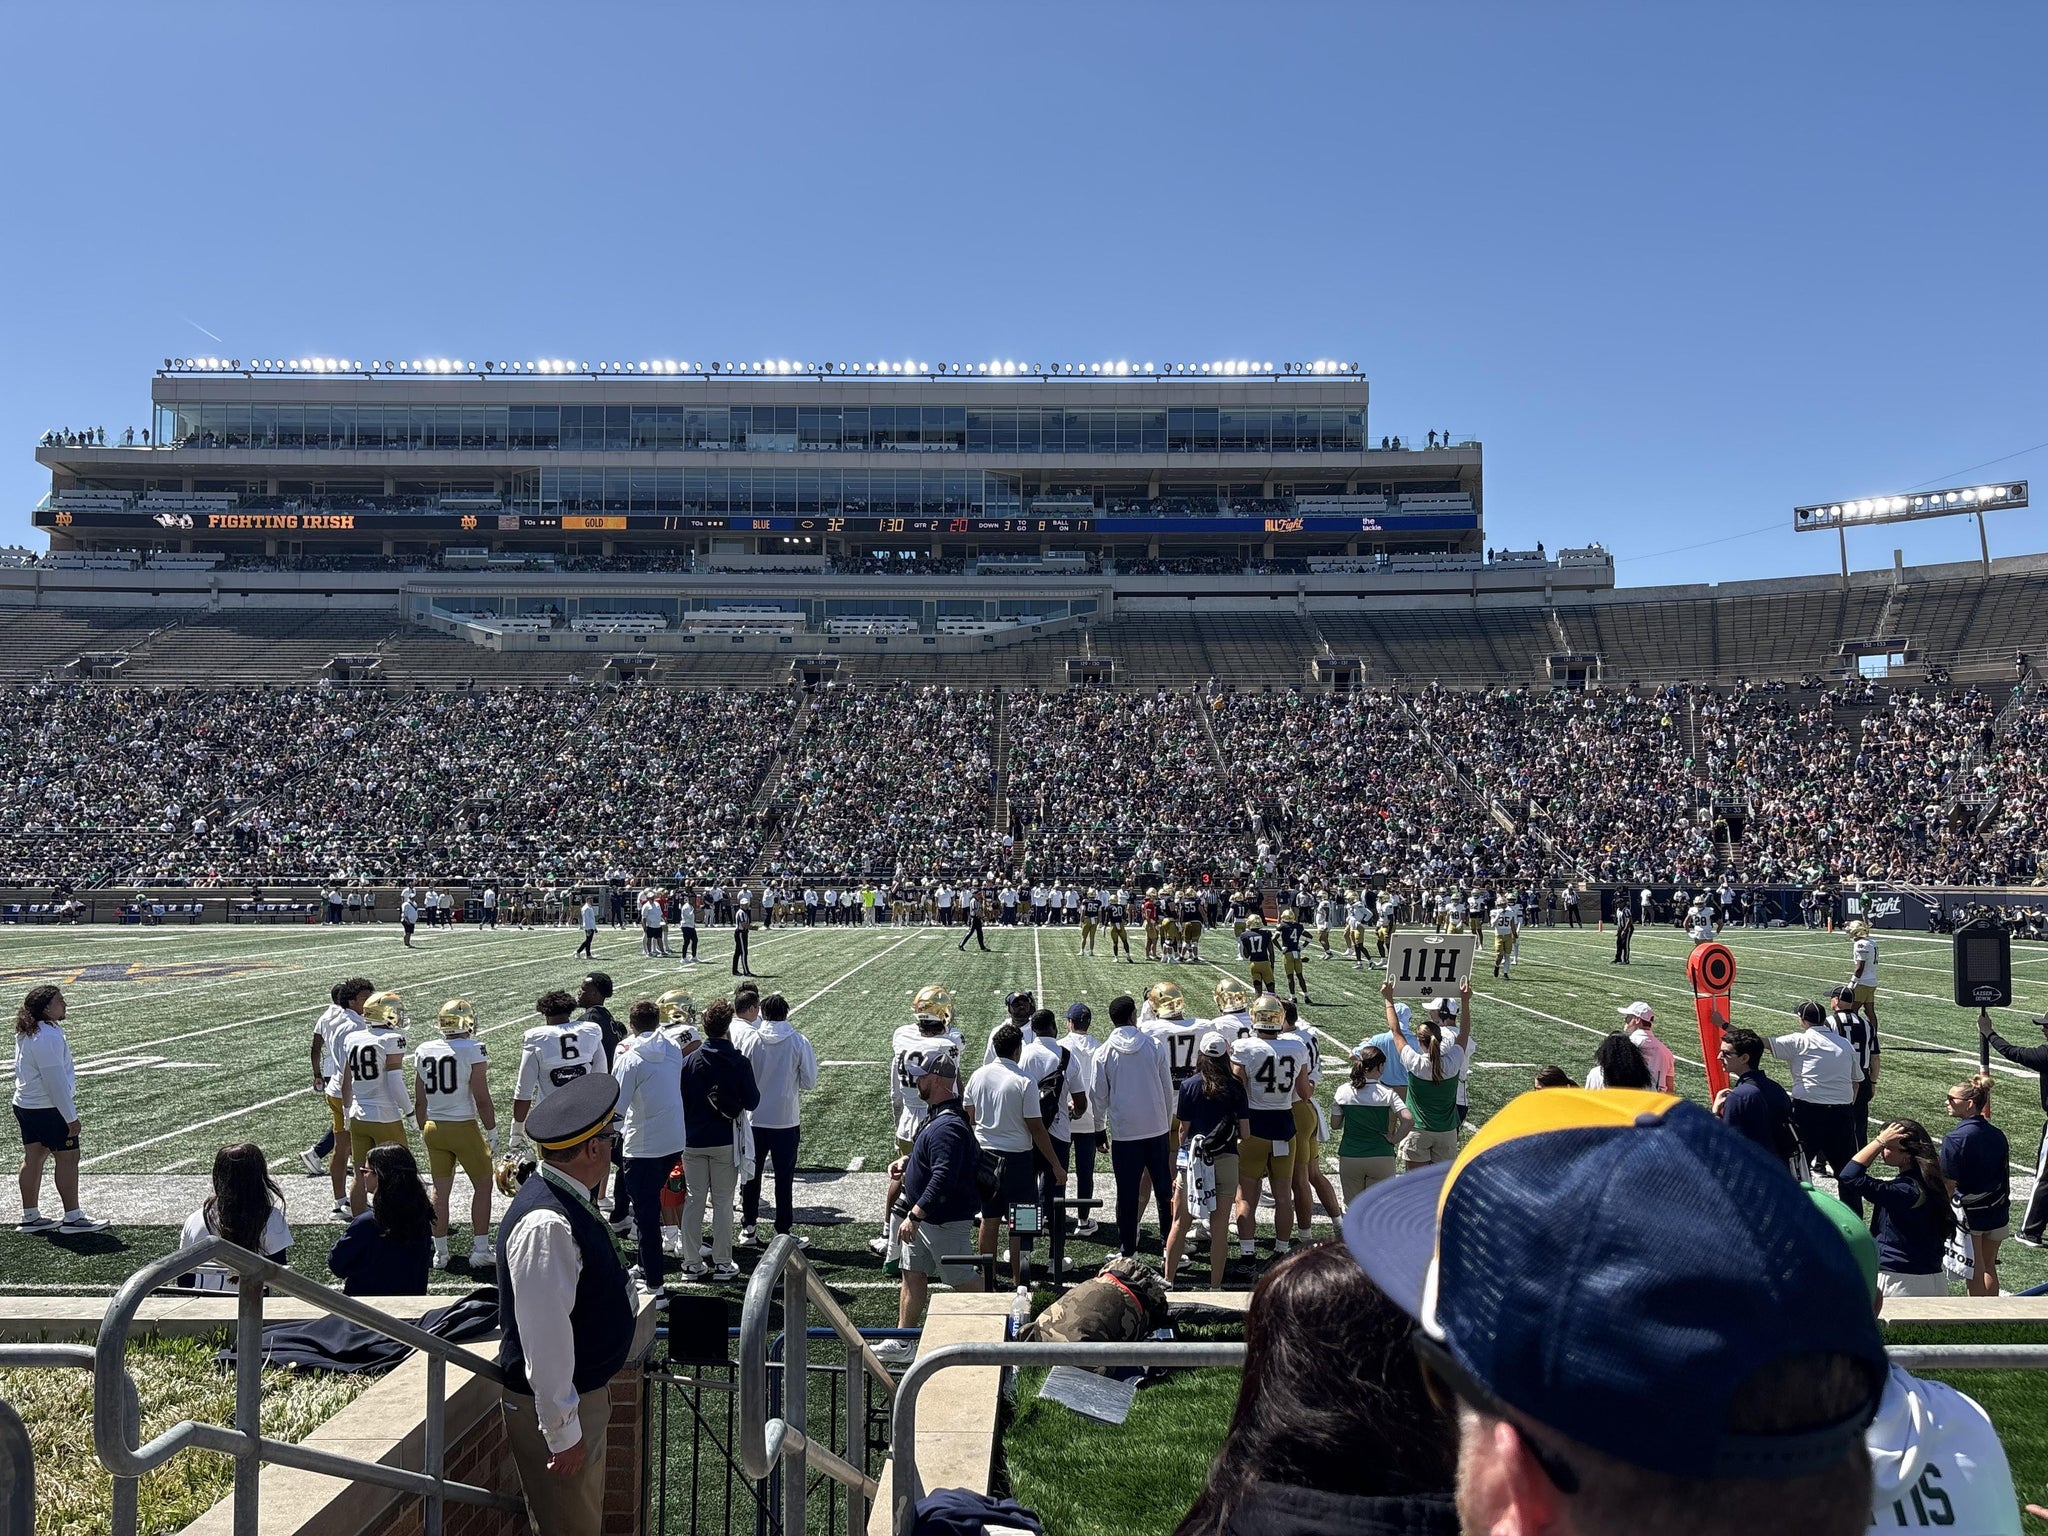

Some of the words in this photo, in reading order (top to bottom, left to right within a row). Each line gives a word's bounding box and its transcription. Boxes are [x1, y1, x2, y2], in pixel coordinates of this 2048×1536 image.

[208, 515, 298, 528] FIGHTING
[302, 515, 354, 529] IRISH
[585, 518, 603, 528] GOLD
[664, 516, 678, 530] 11
[752, 519, 770, 529] BLUE
[827, 518, 844, 532] 32
[879, 519, 904, 532] 1:30
[931, 521, 938, 531] 2
[950, 519, 968, 532] 20
[1004, 521, 1011, 531] 3
[1038, 521, 1046, 531] 8
[1078, 521, 1088, 531] 17
[1202, 874, 1210, 883] 3
[1087, 902, 1099, 913] 85
[1112, 905, 1123, 917] 20
[1184, 901, 1197, 913] 55
[1238, 906, 1245, 917] 11
[1868, 896, 1901, 918] Fight
[1497, 916, 1510, 927] 35
[1695, 916, 1707, 927] 28
[1289, 928, 1298, 943] 4
[1249, 935, 1263, 953] 17
[1400, 948, 1460, 982] 11H
[560, 1033, 580, 1060] 6
[1167, 1034, 1196, 1068] 17
[349, 1045, 380, 1081] 48
[422, 1056, 458, 1095] 30
[1255, 1055, 1296, 1094] 43
[1012, 1308, 1020, 1337] smart
